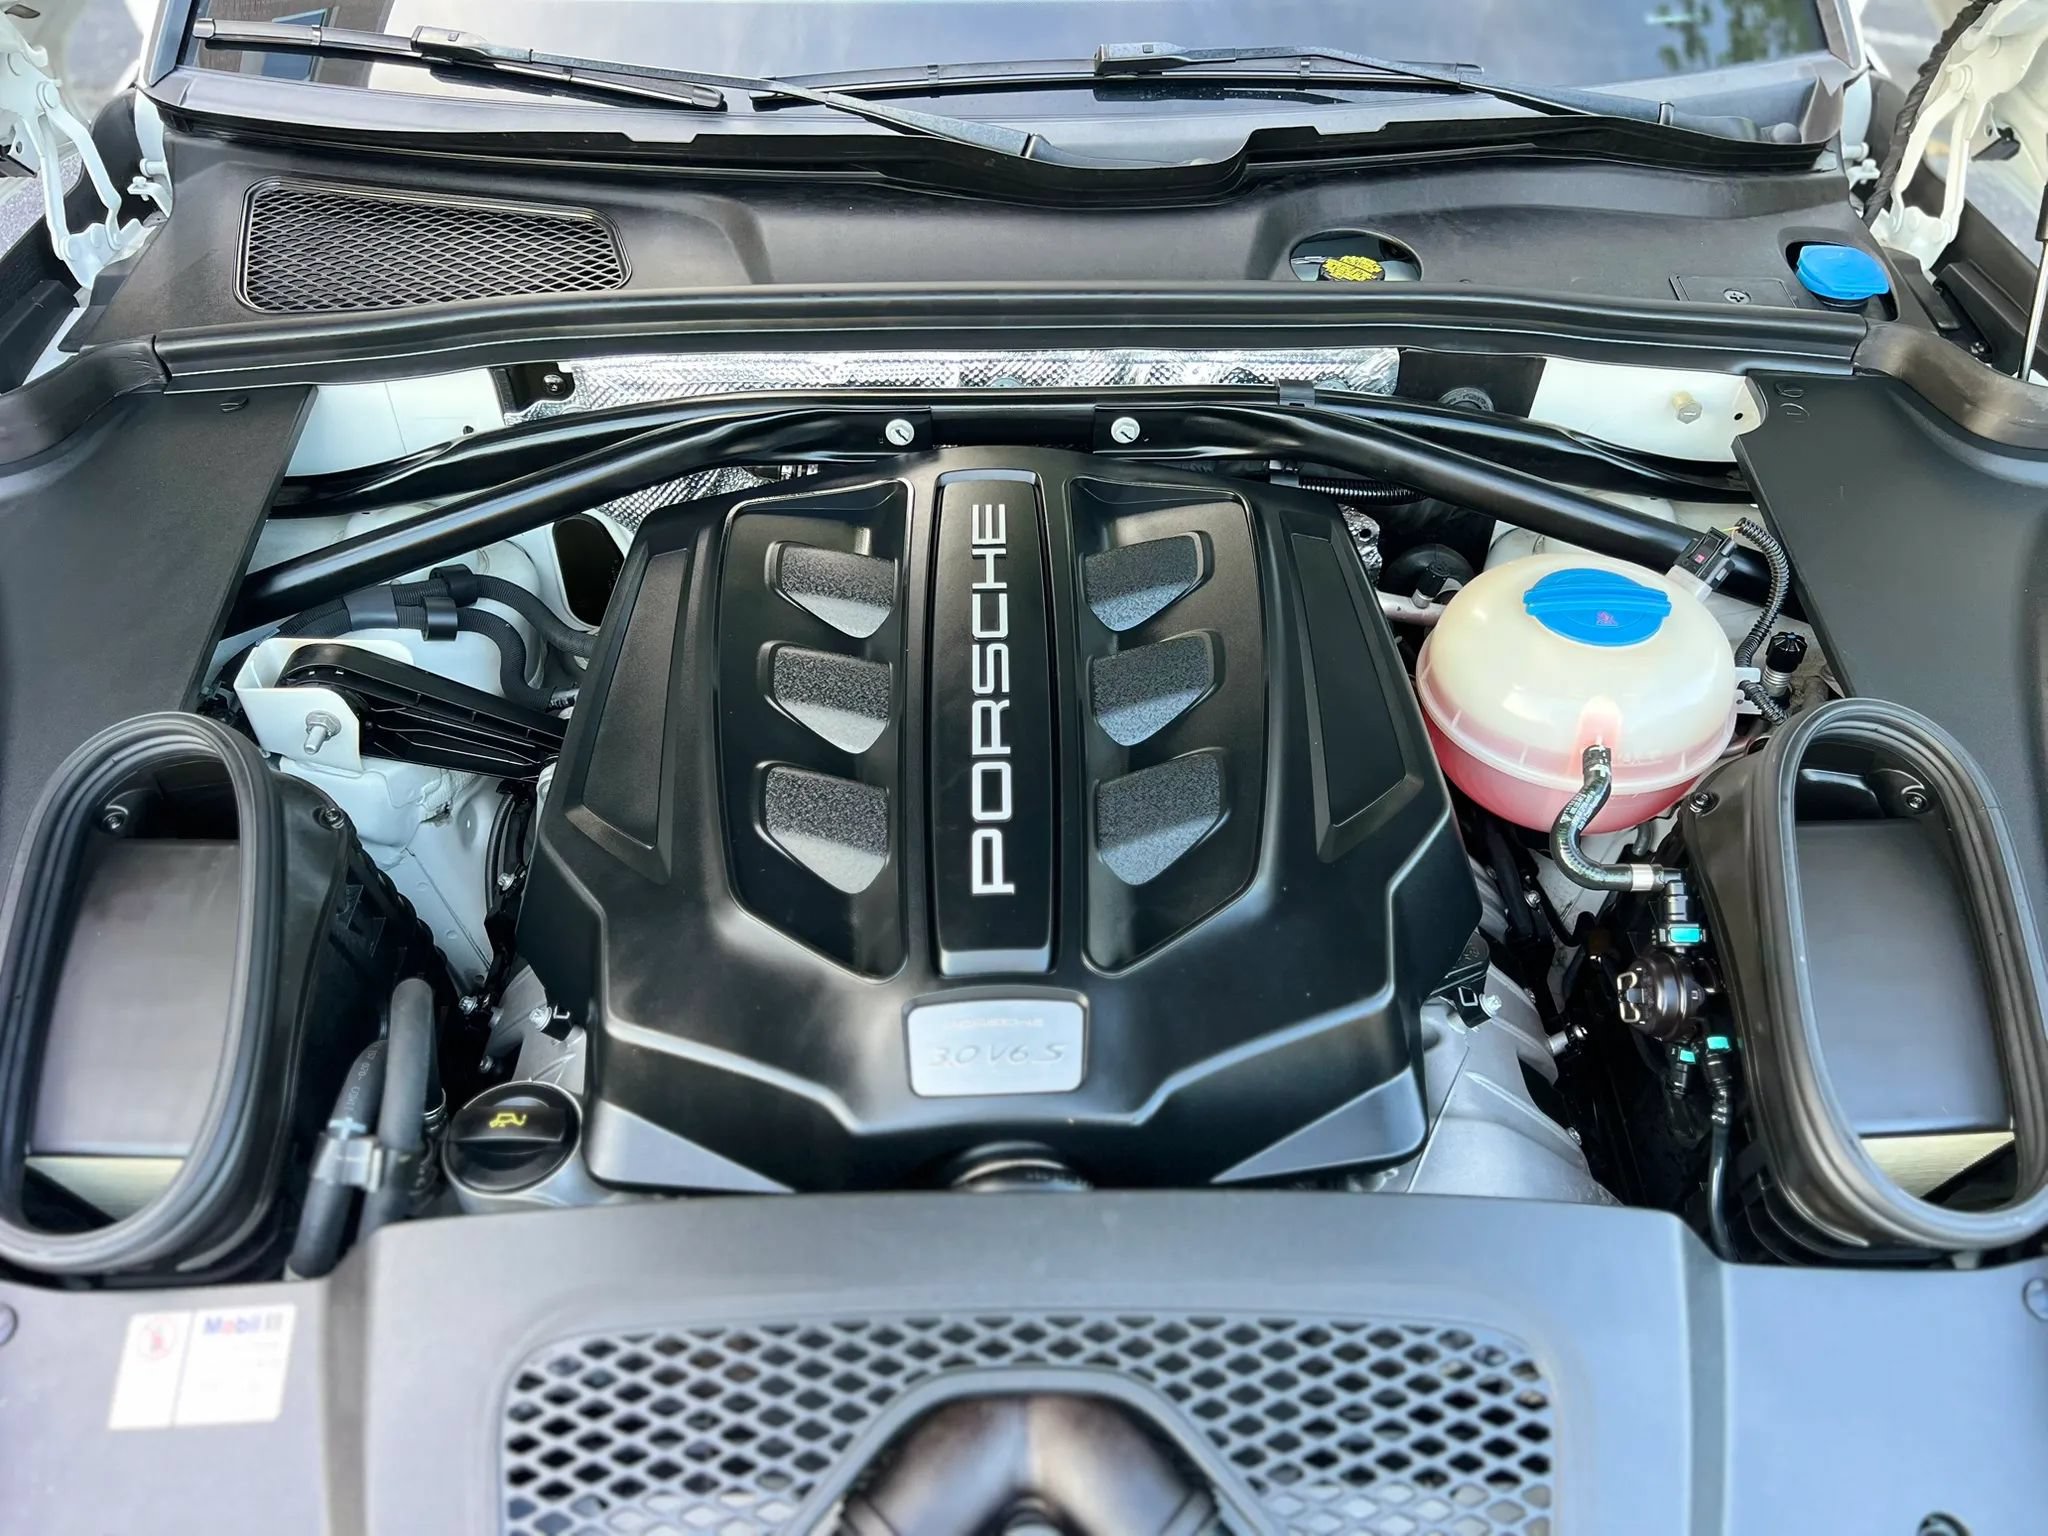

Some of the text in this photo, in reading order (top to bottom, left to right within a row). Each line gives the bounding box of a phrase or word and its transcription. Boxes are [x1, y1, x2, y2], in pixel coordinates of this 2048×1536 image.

[971, 504, 1015, 895] PORSCHE
[1031, 1043, 1069, 1064] S
[203, 1315, 261, 1334] Mobil
